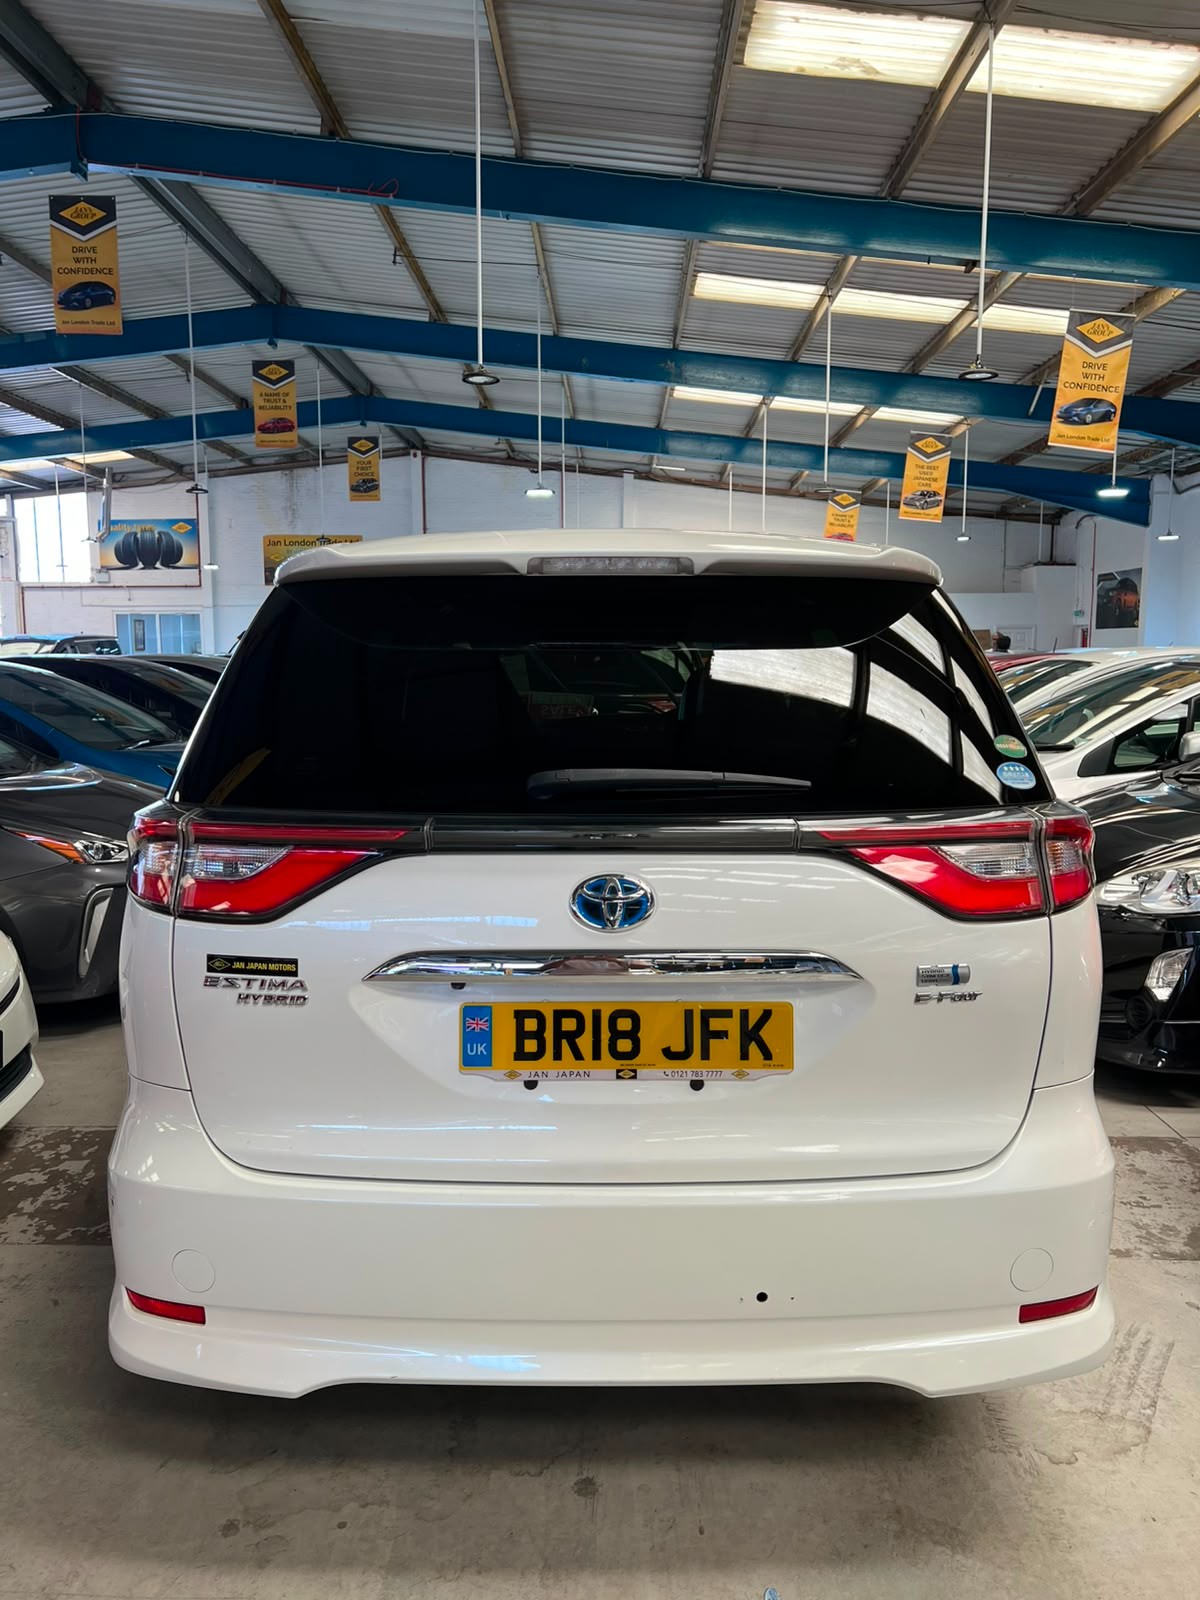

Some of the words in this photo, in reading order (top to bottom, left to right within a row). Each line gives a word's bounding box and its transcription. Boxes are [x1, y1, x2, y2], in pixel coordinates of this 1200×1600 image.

[71, 246, 98, 254] DRIVE
[72, 256, 97, 264] WITH
[57, 266, 114, 275] CONFIDENCE
[1086, 328, 1114, 337] GROUP
[1082, 361, 1108, 371] DRIVE
[1081, 372, 1105, 381] WITH
[1063, 381, 1120, 393] CONFIDENCE
[267, 538, 282, 547] Jan
[283, 538, 317, 547] London
[231, 961, 245, 969] JAN
[246, 962, 267, 970] JAPAN
[268, 963, 297, 972] MOTORS
[203, 976, 308, 992] ESTIMA
[237, 993, 308, 1006] HYBRID
[914, 991, 983, 1004] E-Four
[513, 1008, 641, 1061] BR18
[661, 1008, 773, 1061] JFK
[466, 1043, 488, 1056] UK
[528, 1071, 549, 1079] JAN
[555, 1070, 591, 1079] JAPAN
